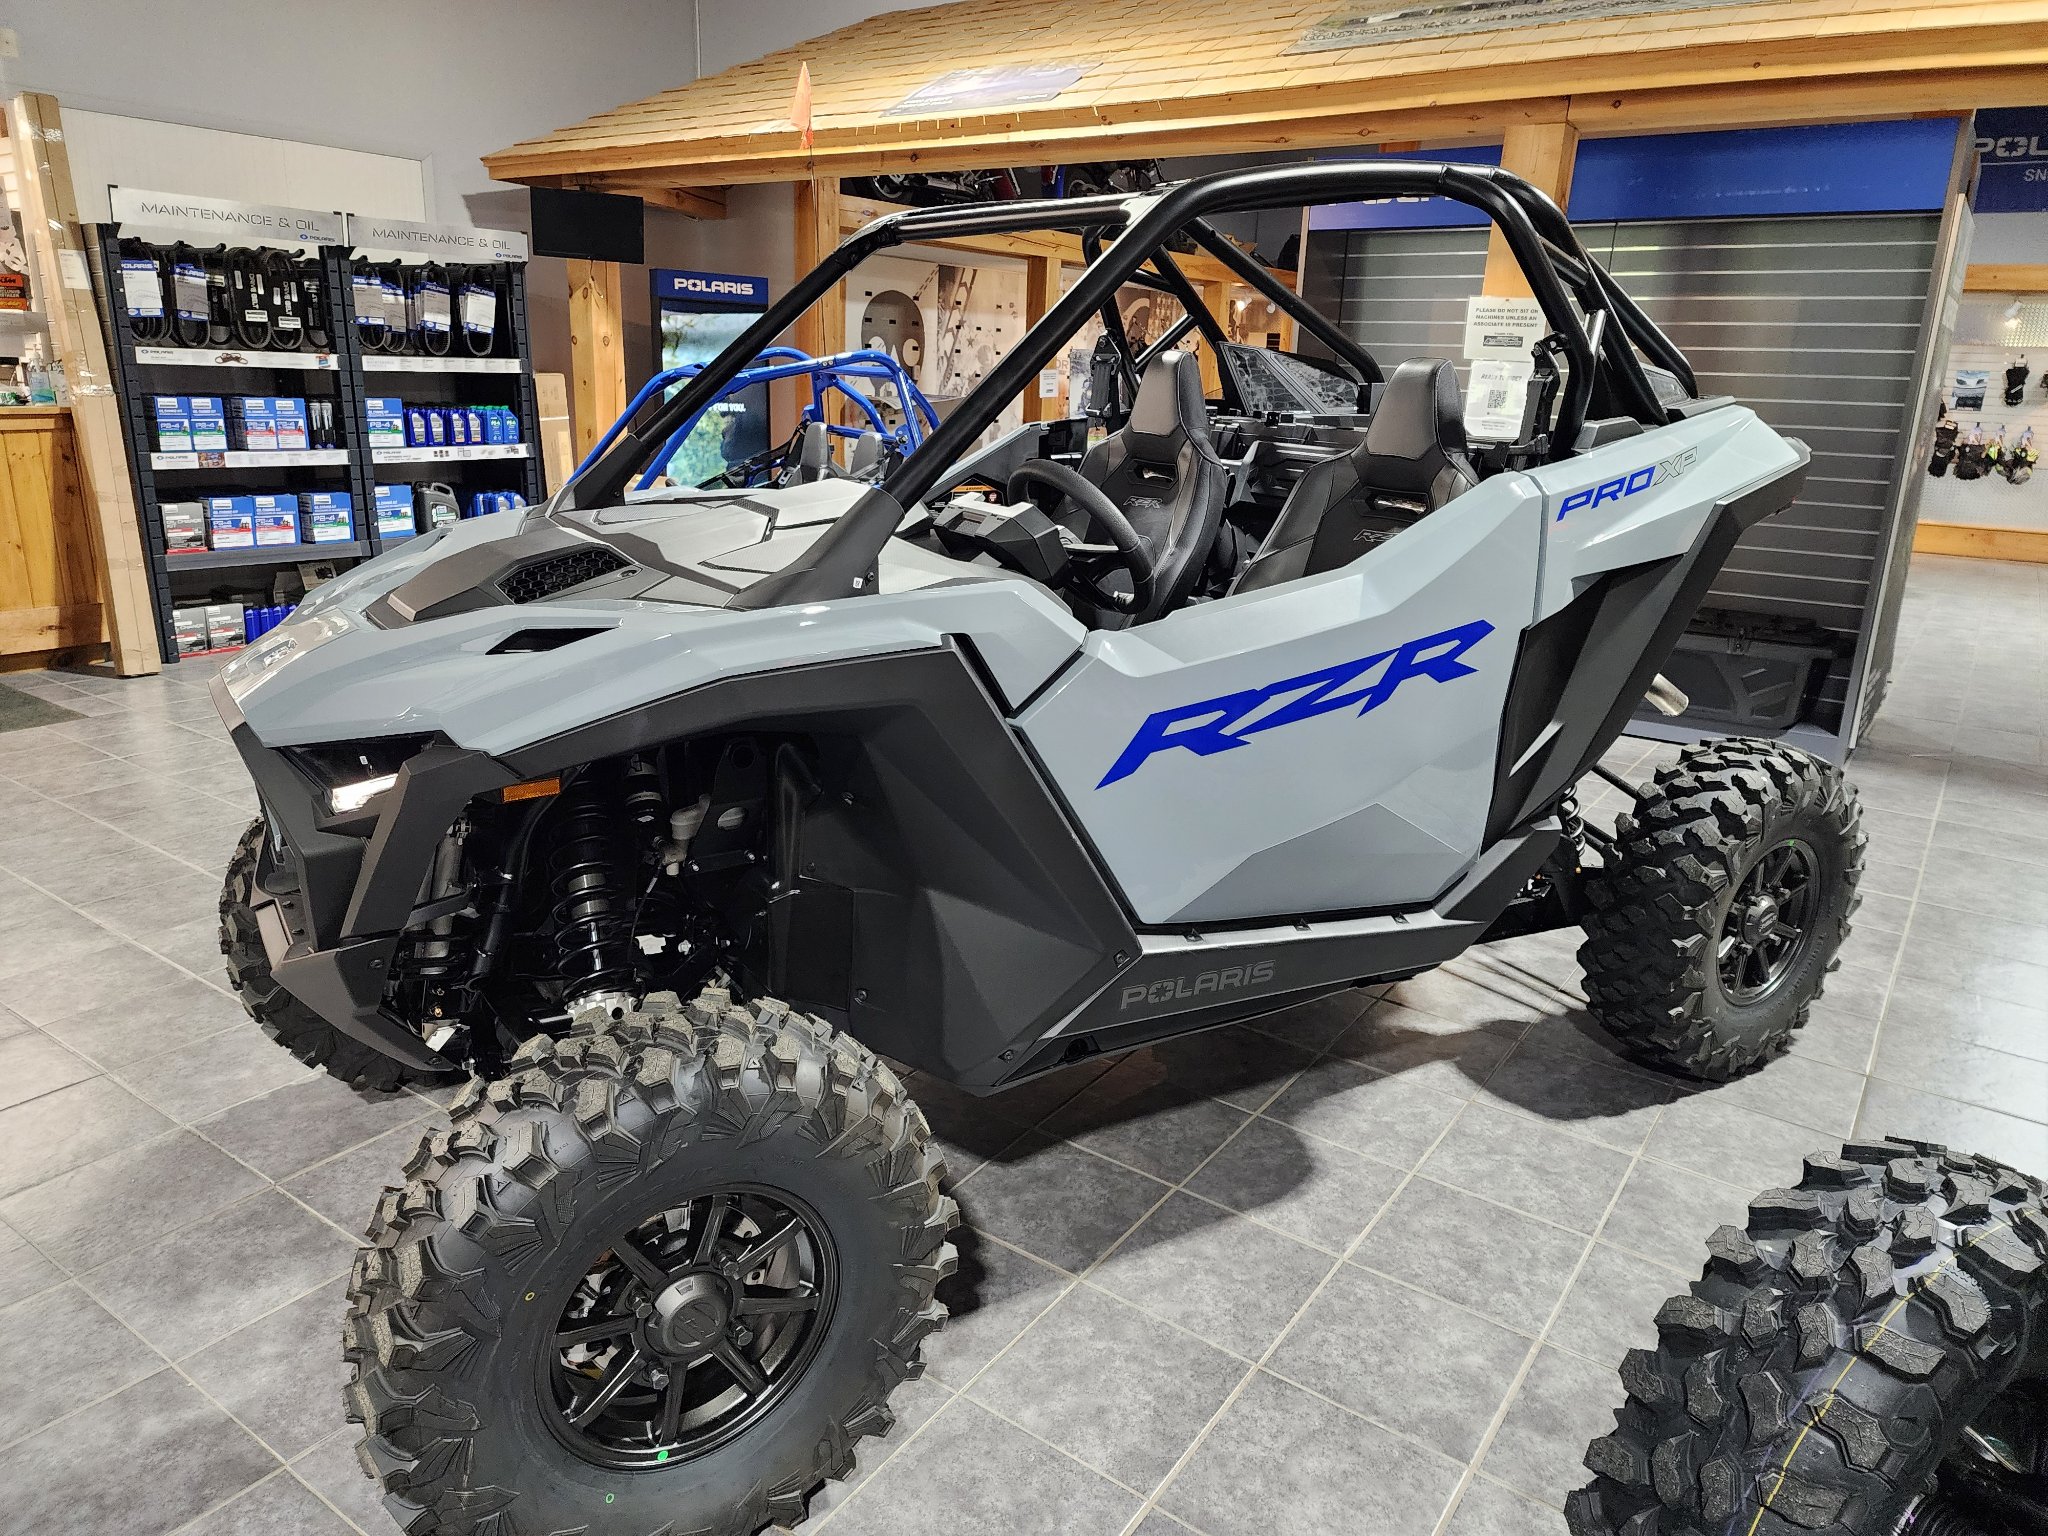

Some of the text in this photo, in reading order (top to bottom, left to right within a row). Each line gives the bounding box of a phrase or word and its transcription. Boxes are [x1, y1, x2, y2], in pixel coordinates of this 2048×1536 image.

[141, 202, 320, 232] MAINTENANCE & OIL
[309, 235, 335, 243] POLARIS
[372, 228, 511, 250] MAINTENANCE & OIL
[674, 277, 753, 295] POLARIS
[1556, 445, 1698, 522] PRO XP
[1353, 529, 1400, 542] RZ
[1094, 619, 1496, 791] RZR
[1119, 960, 1276, 1010] POLARIS
